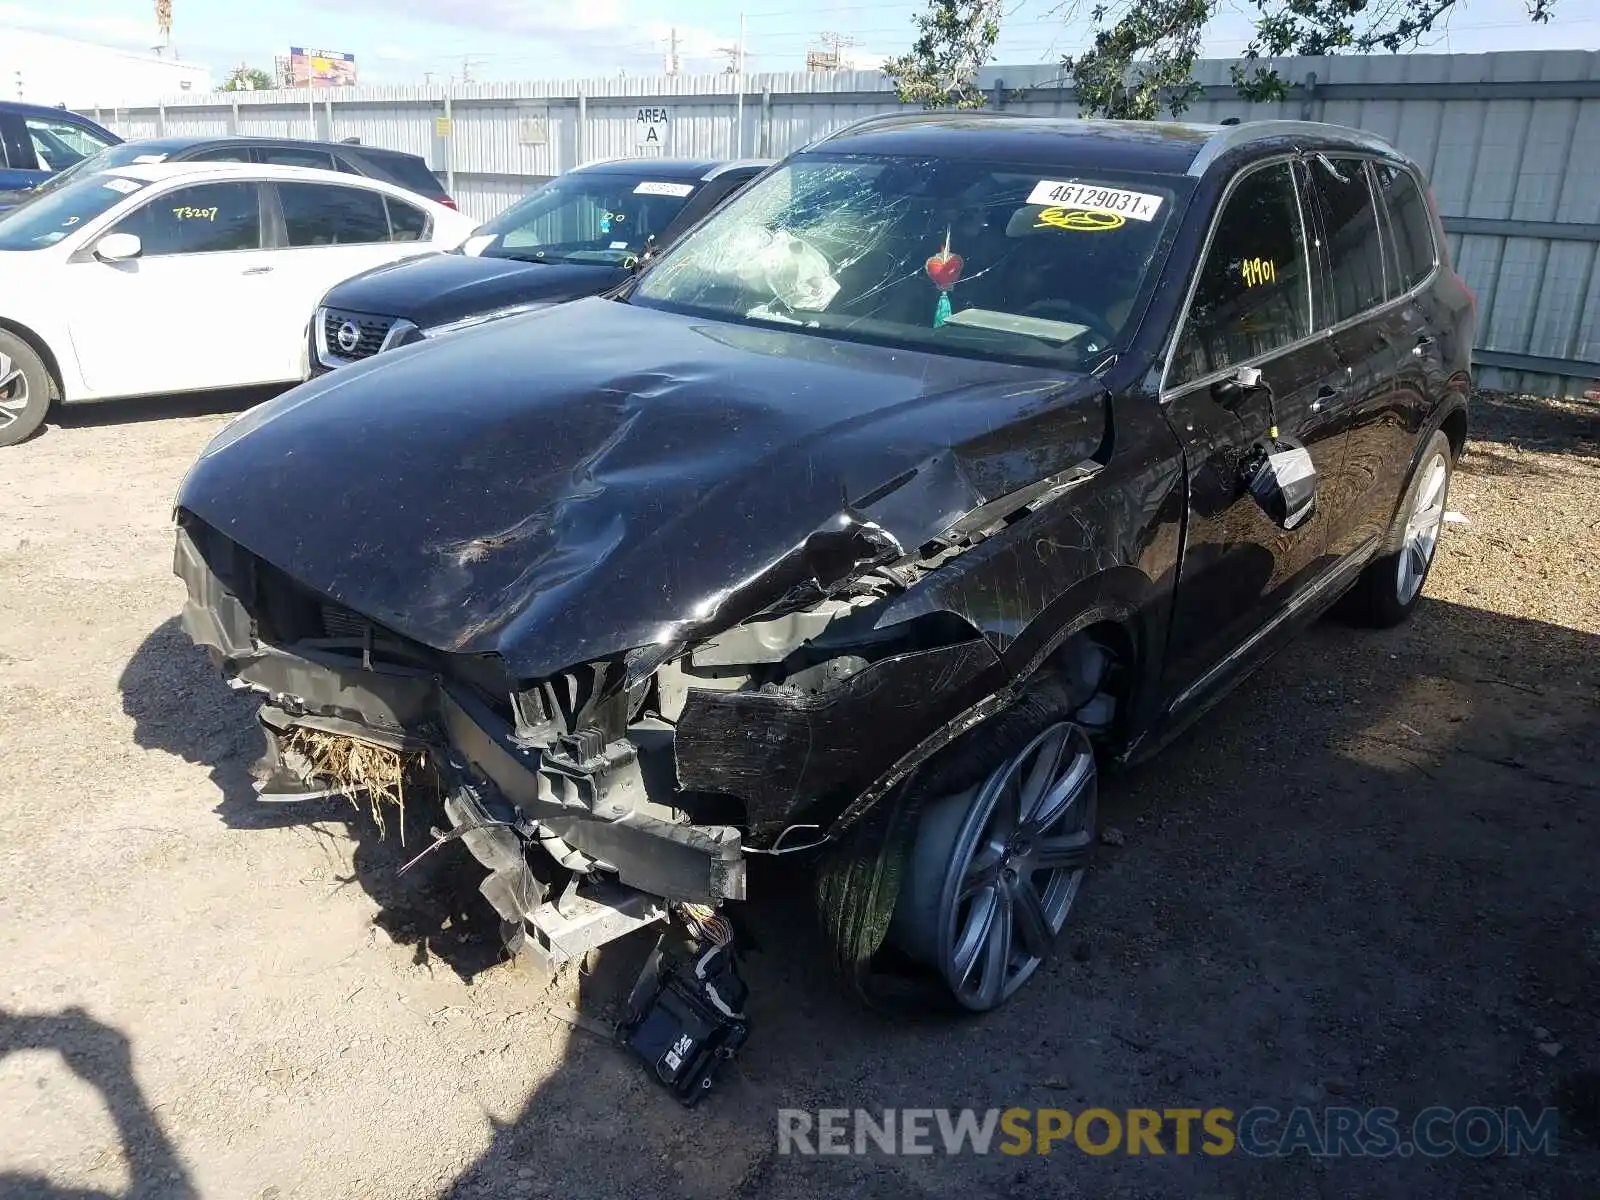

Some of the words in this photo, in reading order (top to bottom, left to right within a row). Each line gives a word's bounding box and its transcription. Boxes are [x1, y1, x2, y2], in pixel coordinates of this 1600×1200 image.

[636, 108, 668, 123] AREA
[646, 126, 658, 142] A
[172, 206, 219, 222] 73207
[1242, 257, 1276, 288] 41901
